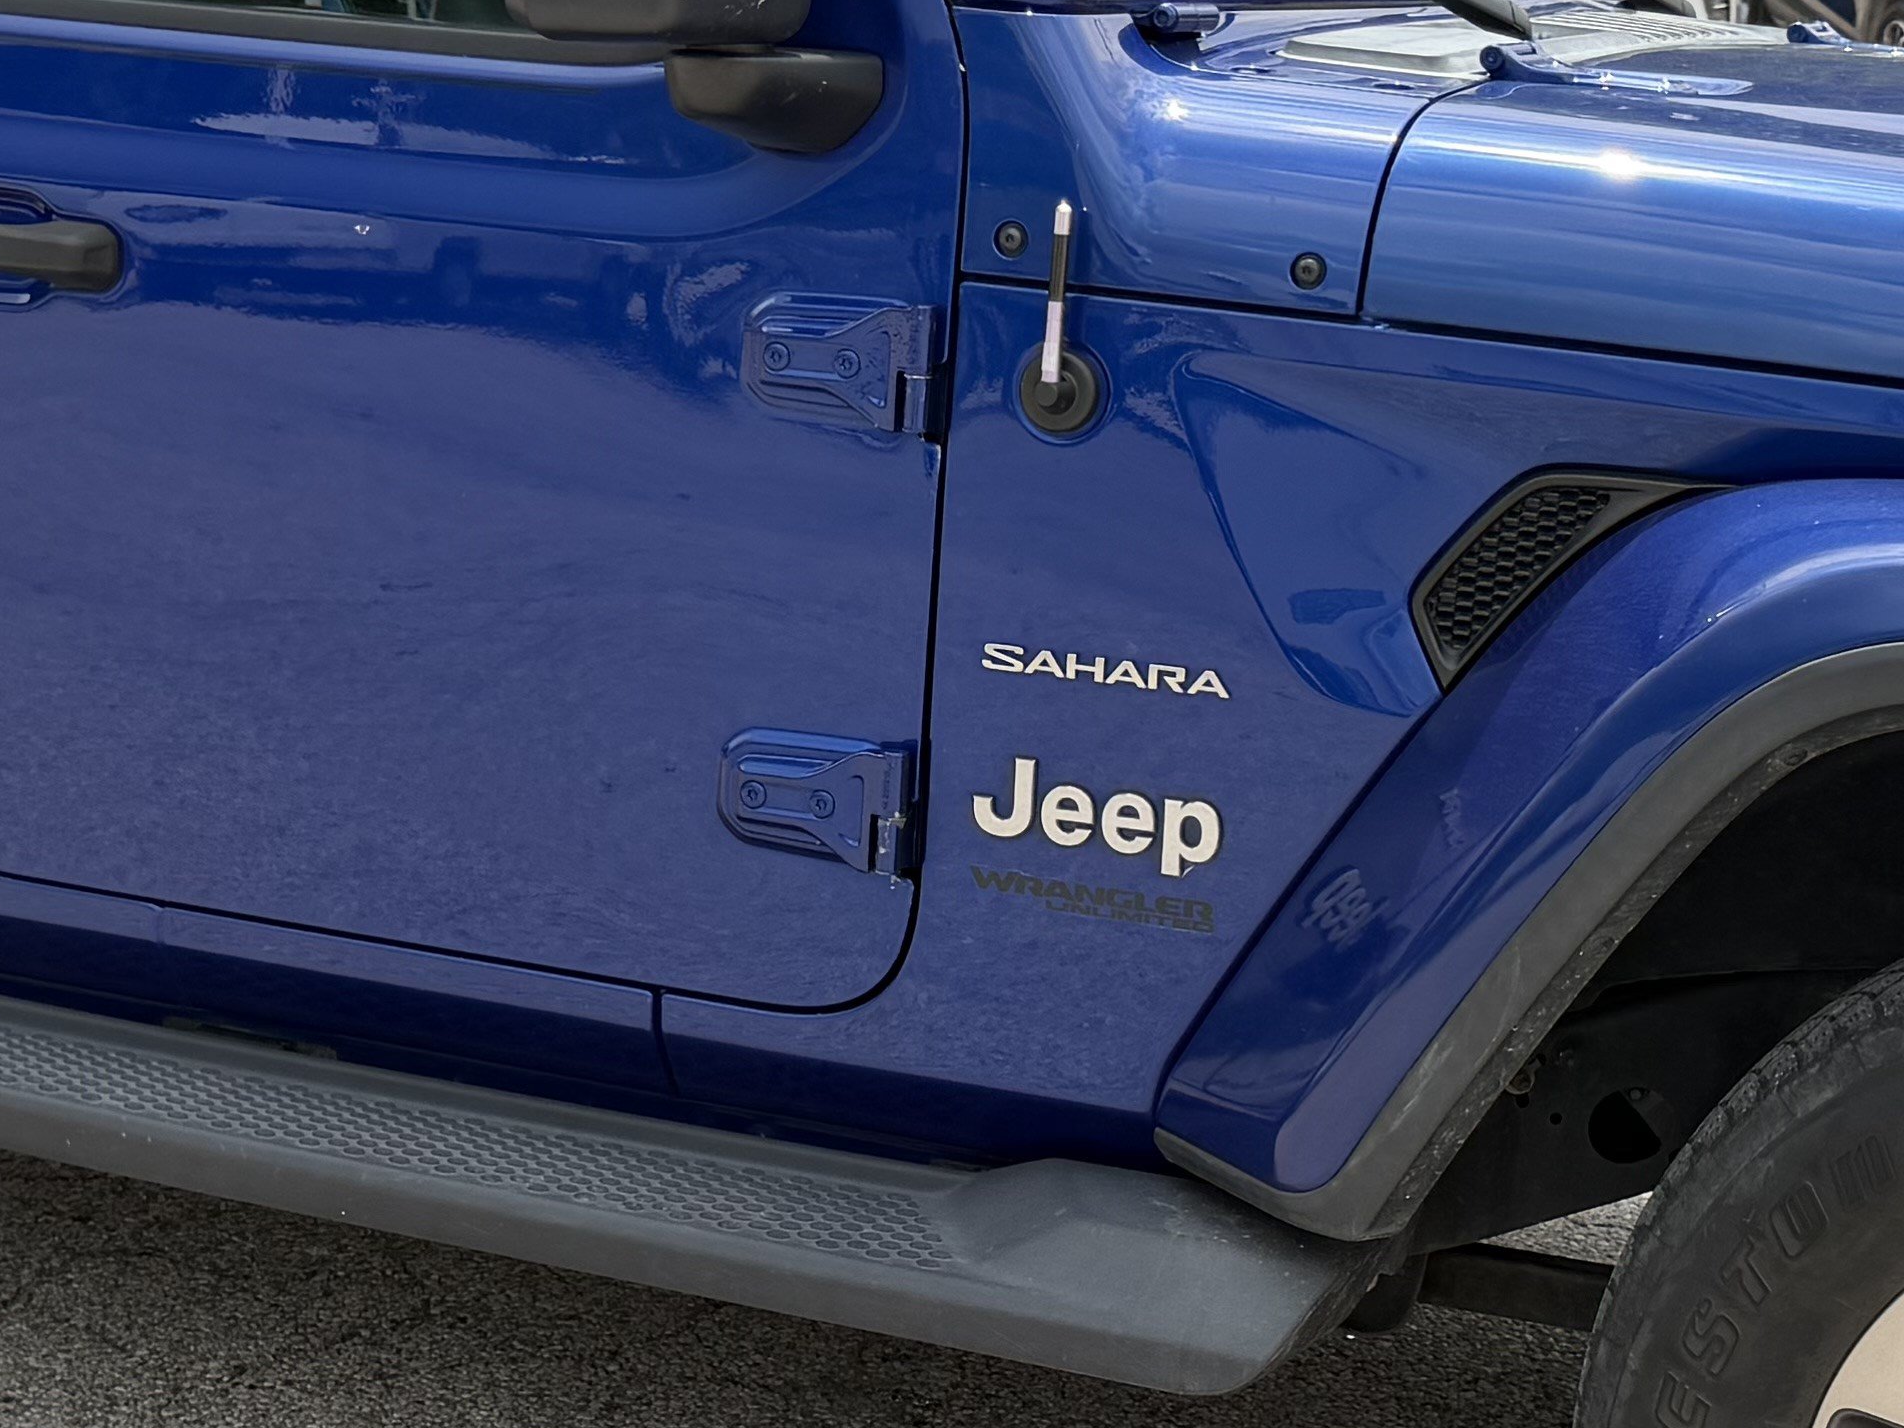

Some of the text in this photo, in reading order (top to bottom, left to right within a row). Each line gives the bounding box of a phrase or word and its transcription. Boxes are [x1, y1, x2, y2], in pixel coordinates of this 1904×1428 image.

[980, 642, 1231, 699] SAHARA
[972, 756, 1222, 878] Jeep
[970, 865, 1214, 922] WRANGLER
[1045, 898, 1215, 933] UNLIMITED
